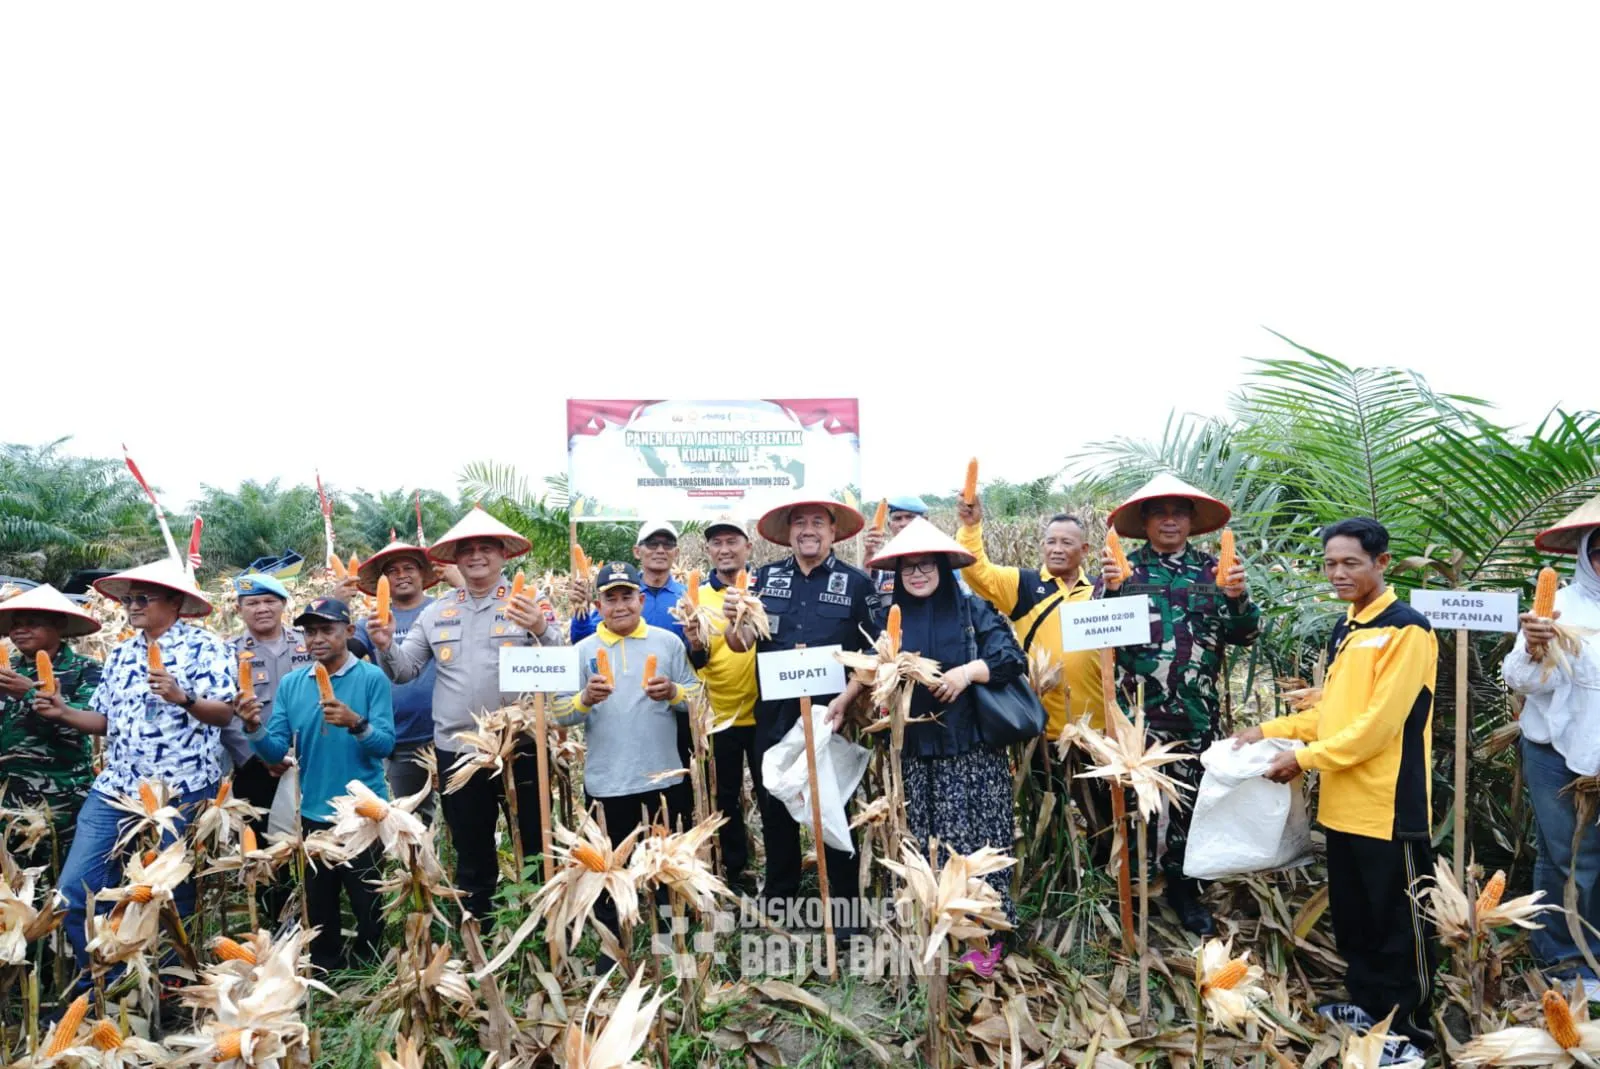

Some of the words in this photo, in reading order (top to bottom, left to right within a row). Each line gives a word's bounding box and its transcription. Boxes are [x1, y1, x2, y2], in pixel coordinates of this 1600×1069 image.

[625, 430, 664, 447] PANEN
[665, 430, 696, 447] RAYA
[696, 430, 742, 447] JAGUNG
[743, 430, 803, 447] SERENTAK
[681, 447, 733, 463] KUARTAL
[637, 477, 678, 487] MENDUKUNG
[678, 477, 724, 487] SWASEMBADA
[724, 477, 750, 487] PANGAN
[751, 477, 772, 487] TAHUN
[773, 477, 790, 486] 2025
[820, 593, 851, 605] BUPATI
[1441, 598, 1484, 608] KADIS
[1073, 615, 1109, 626] DANDIM
[1424, 611, 1503, 623] PERTANIAN
[1084, 625, 1122, 636] ASAHAN
[511, 665, 567, 674] KAPOLRES
[779, 667, 827, 681] BUPATI
